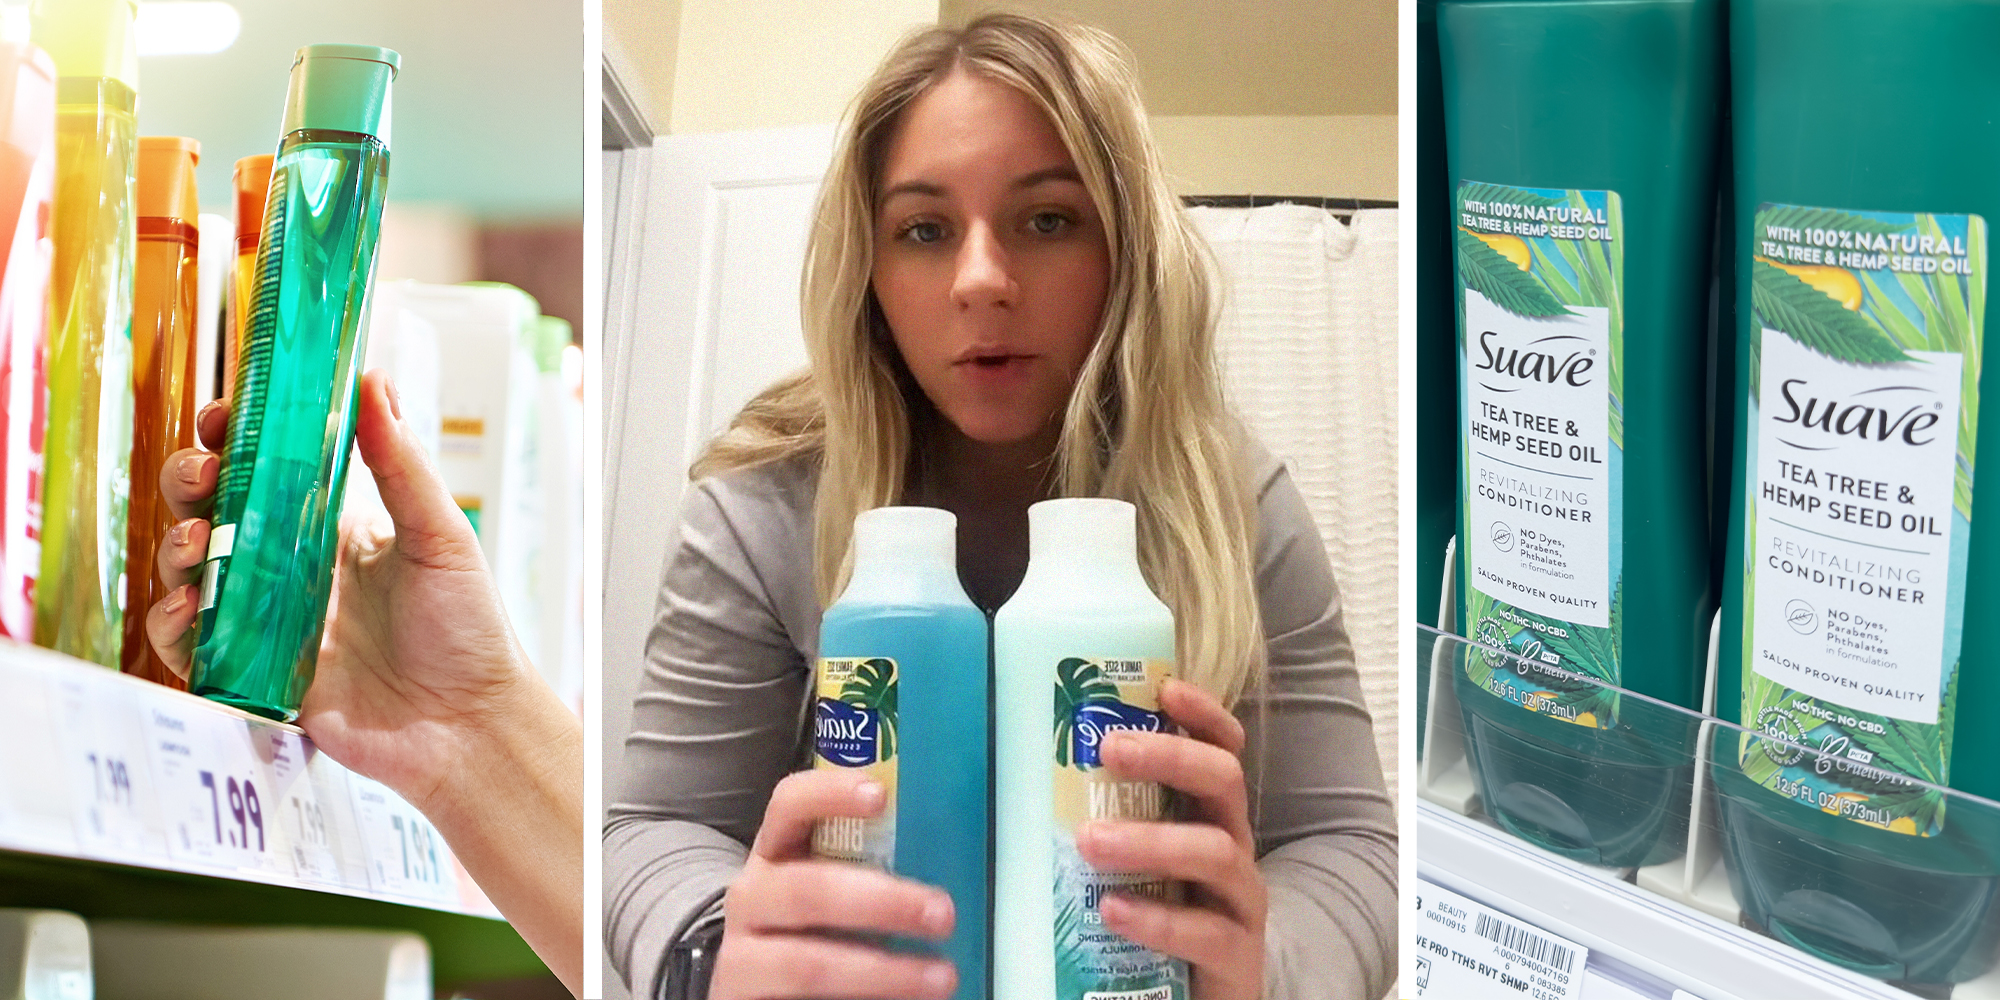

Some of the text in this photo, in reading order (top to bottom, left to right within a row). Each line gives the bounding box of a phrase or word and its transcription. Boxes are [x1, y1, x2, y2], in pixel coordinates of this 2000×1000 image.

[1462, 213, 1613, 242] TEA TREE & HEMP SEED OIL
[1464, 199, 1607, 225] WITH 100% NATURAL
[1766, 225, 1967, 256] WITH 100% NATURAL
[1761, 241, 1973, 276] TEA TREE & HEMP SEED OIL
[1475, 331, 1594, 387] Suave
[1480, 401, 1579, 438] TEA TREE &
[1772, 379, 1939, 446] Suave
[1471, 421, 1602, 464] HEMP SEED OIL
[1480, 468, 1588, 506] REVITALIZING
[1777, 459, 1915, 506] TEA TREE &
[1478, 484, 1592, 523] CONDITIONER
[1762, 481, 1942, 536] HEMP SEED OIL
[1520, 528, 1565, 549] NO Dyes,
[1520, 539, 1562, 558] Parabens,
[1520, 549, 1567, 568] Phthalates
[1520, 561, 1575, 581] in formulation
[1773, 537, 1921, 585] REVITALIZING
[1478, 567, 1598, 609] SALON PROVEN QUALITY
[1768, 555, 1925, 605] CONDITIONER
[1499, 609, 1570, 639] NO THC. NO CBD.
[1827, 608, 1888, 633] NO Dyes,
[1827, 621, 1884, 644] Parabens,
[1481, 631, 1507, 651] 100%
[1825, 646, 1898, 670] in formulation
[1826, 632, 1889, 655] Phthalates
[1762, 650, 1925, 703] SALON PROVEN QUALITY
[1489, 678, 1577, 722] 12.6 FL OZ (373mL)
[1792, 699, 1887, 736] NO THC. NO CBD.
[1757, 705, 1808, 740] BOTTLE MADE FROM
[1763, 723, 1799, 745] 100%
[199, 769, 265, 852] 7.99
[1775, 776, 1890, 827] 12.6 FL OZ (373mL)
[1426, 909, 1467, 934] 00010915
[1438, 901, 1468, 920] BEAUTY
[1429, 940, 1449, 958] PRO
[1451, 949, 1476, 972] TTHS
[1478, 961, 1499, 980] RVT
[1500, 972, 1529, 994] SHMP
[1505, 962, 1510, 971] 6
[1536, 978, 1567, 997] 083385
